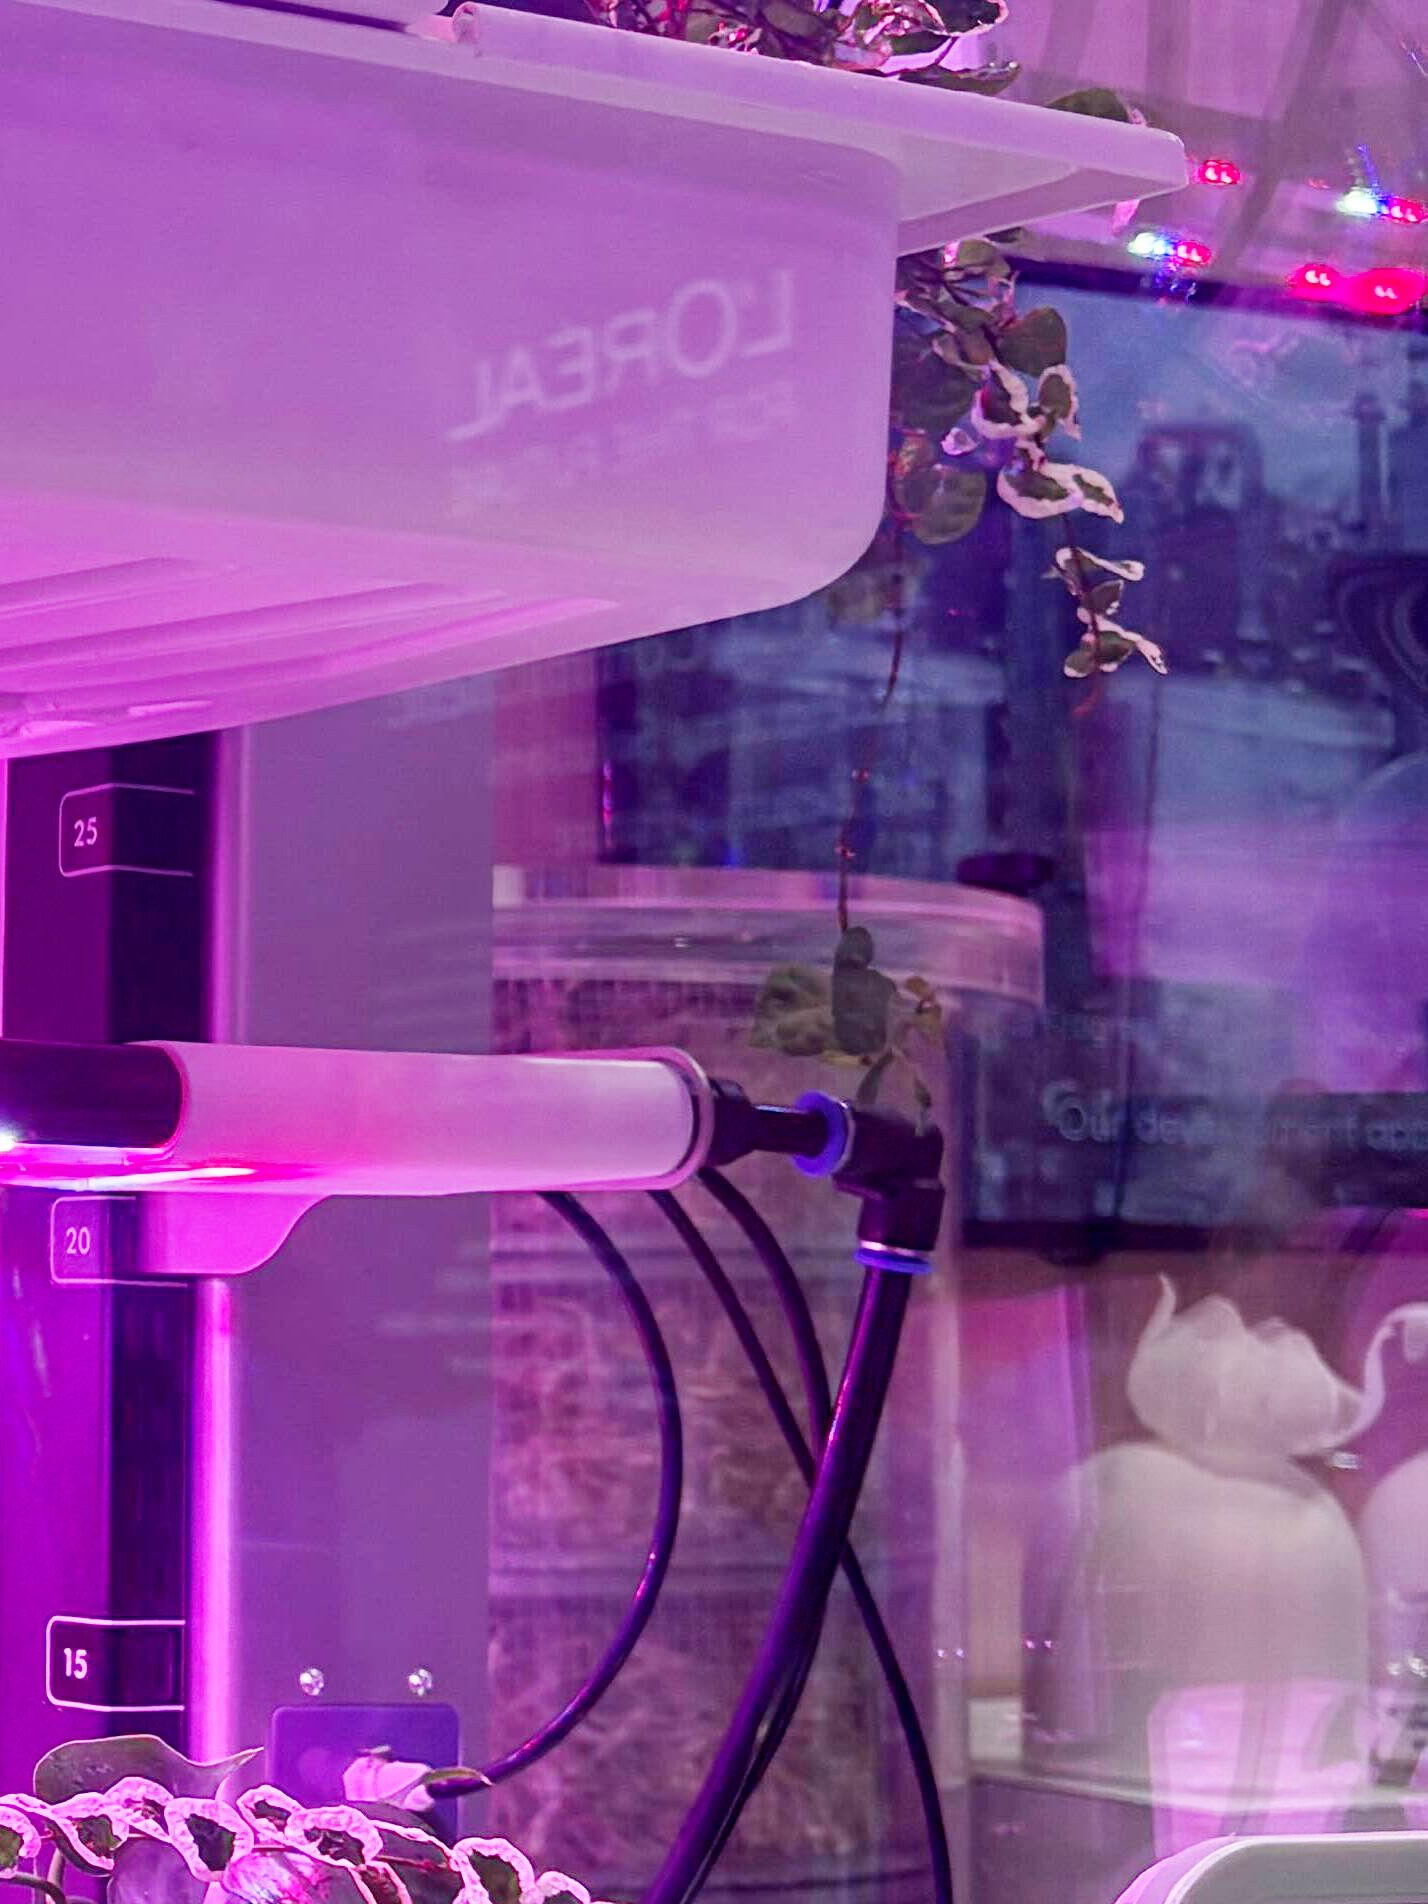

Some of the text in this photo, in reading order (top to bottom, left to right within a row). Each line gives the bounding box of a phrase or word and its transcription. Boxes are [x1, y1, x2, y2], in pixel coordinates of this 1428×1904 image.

[73, 816, 98, 848] 25
[65, 1225, 92, 1256] 20
[64, 1647, 89, 1680] 15
